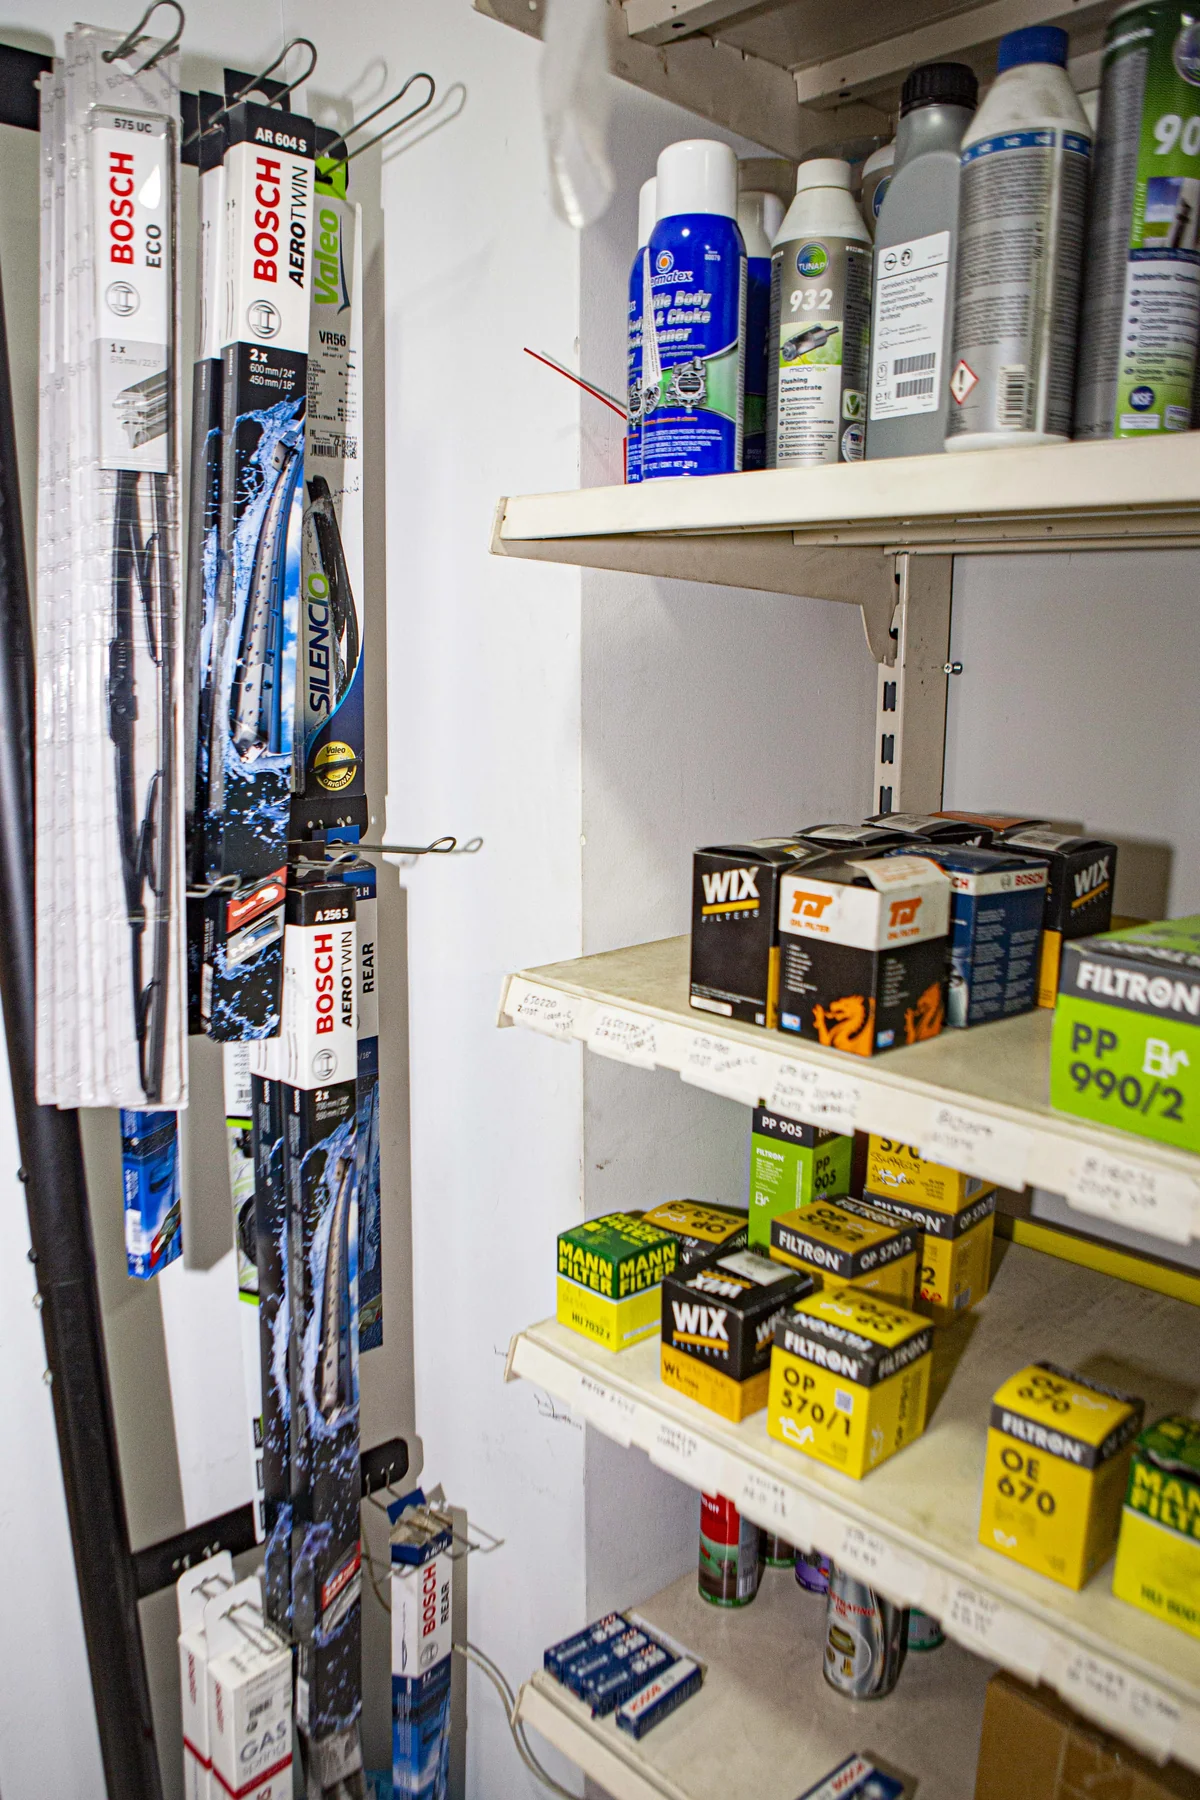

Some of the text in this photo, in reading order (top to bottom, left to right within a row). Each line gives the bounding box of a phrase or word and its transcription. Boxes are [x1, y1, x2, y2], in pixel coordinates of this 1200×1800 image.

[114, 118, 153, 133] 575 UC
[254, 127, 307, 153] AR 604 S
[109, 151, 135, 265] BOSCH
[254, 156, 281, 284] BOSCH
[289, 165, 308, 290] AEROTWIN
[145, 223, 162, 269] ECO
[313, 208, 339, 305] Valeo
[650, 269, 694, 289] ermatex
[798, 262, 828, 271] TUNAP
[655, 308, 712, 327] & Choke
[674, 290, 712, 309] Body
[789, 287, 834, 313] 932
[110, 343, 117, 353] 1
[249, 347, 268, 363] 2 x
[318, 330, 347, 347] VR56
[249, 363, 264, 375] 600
[265, 366, 279, 377] mm
[249, 375, 264, 386] 450
[264, 378, 279, 388] mm
[781, 377, 809, 386] Flushing
[308, 572, 330, 715] SILENCIO
[326, 746, 346, 754] Valeo
[323, 771, 353, 787] ORIGINAL
[363, 886, 370, 896] H
[702, 866, 760, 904] WIX
[1015, 872, 1045, 887] BOSCH
[1074, 855, 1110, 898] WIX
[315, 908, 349, 922] A 256 S
[701, 908, 760, 923] FILTERS
[314, 933, 334, 1035] BOSCH
[341, 931, 352, 1027] AEROTWIN
[362, 942, 374, 994] REAR
[1076, 960, 1200, 1017] FILTRON
[1069, 1021, 1120, 1060] PP
[314, 1090, 330, 1102] 2 x
[1068, 1061, 1185, 1122] 990/2
[761, 1115, 803, 1138] PP 905
[756, 1147, 785, 1163] FILTRON
[815, 1155, 831, 1175] PP
[814, 1169, 837, 1191] 905
[559, 1239, 613, 1280] MANN
[619, 1242, 676, 1281] MANN
[778, 1229, 841, 1272] FILTRON
[859, 1235, 912, 1271] OP 570/2
[559, 1256, 613, 1297] FILTER
[619, 1260, 676, 1297] FILTER
[571, 1311, 584, 1326] HU
[682, 1300, 729, 1342] WIX
[755, 1315, 776, 1343] WI
[663, 1360, 681, 1380] WL
[784, 1329, 859, 1381] FILTRON
[878, 1332, 929, 1381] FILTRON
[783, 1366, 816, 1392] OP
[781, 1388, 851, 1438] 570/1
[1001, 1410, 1083, 1464] FILTRON
[1000, 1447, 1042, 1486] OE
[996, 1474, 1057, 1518] 670
[422, 1561, 437, 1638] BOSCH
[440, 1580, 450, 1625] REAR
[240, 1719, 287, 1763] GAS
